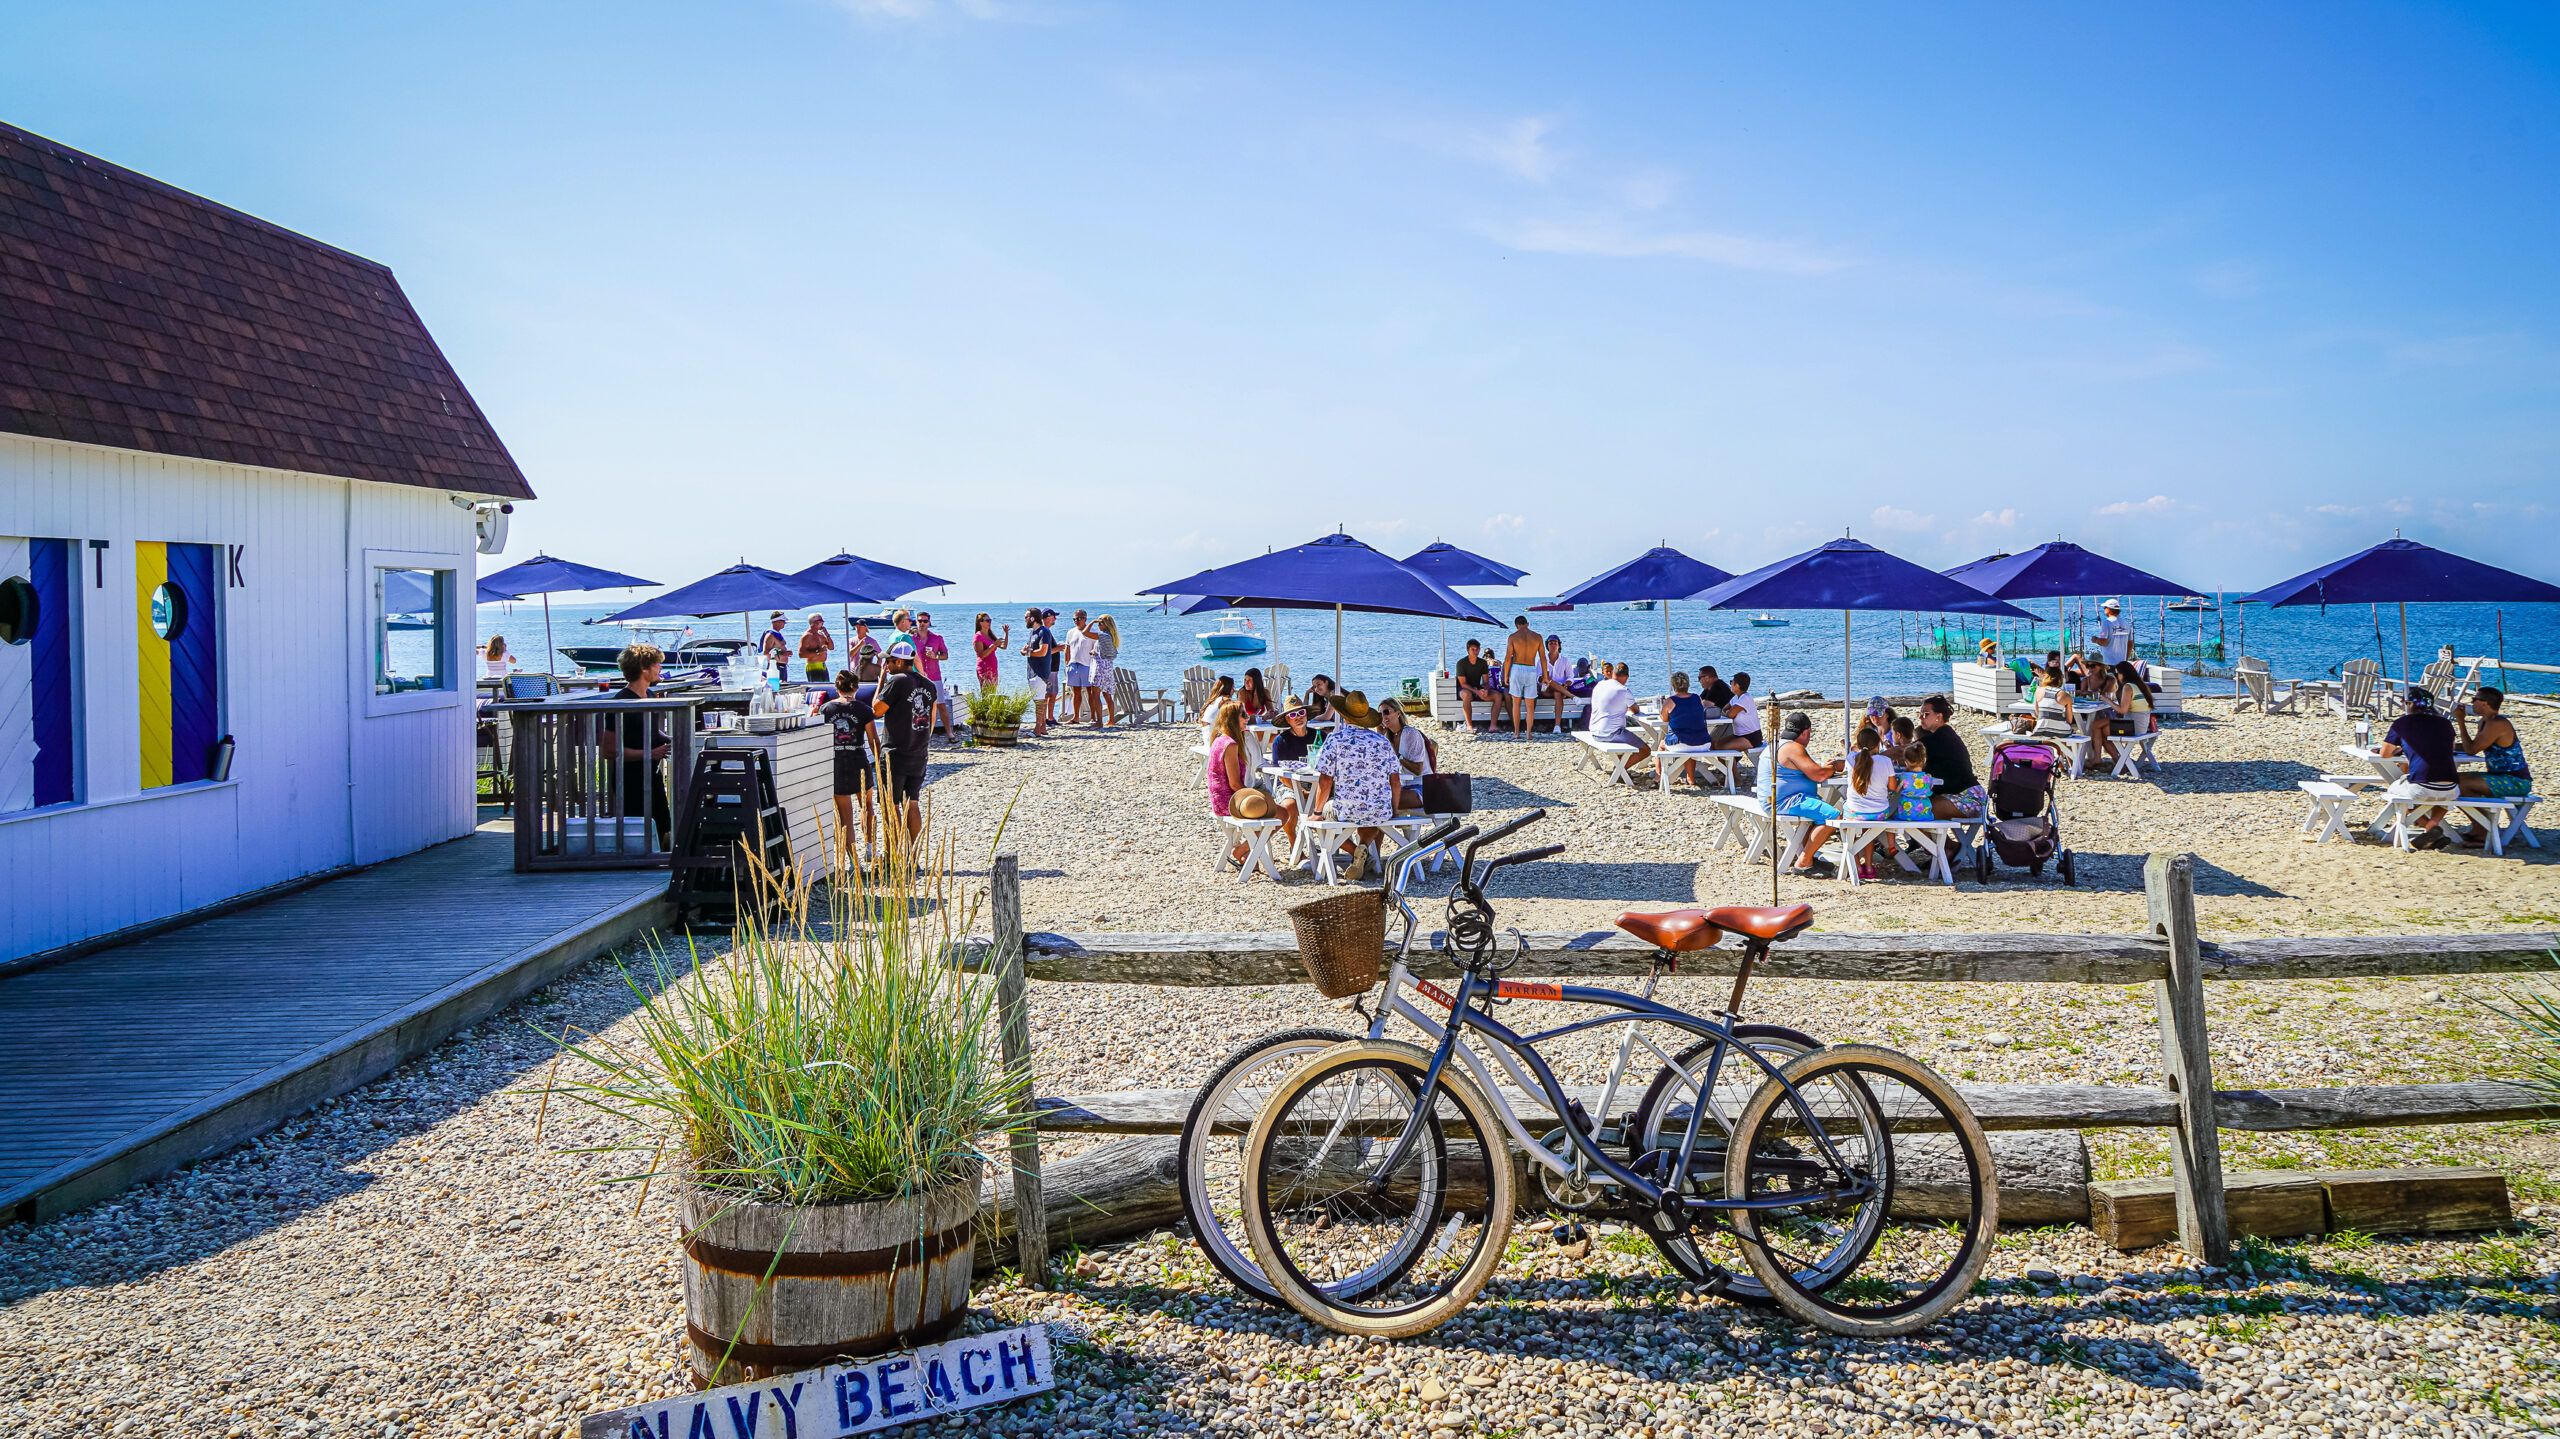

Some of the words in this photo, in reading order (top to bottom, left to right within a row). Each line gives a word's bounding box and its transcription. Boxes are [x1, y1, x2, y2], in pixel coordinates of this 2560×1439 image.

[89, 540, 109, 588] T
[228, 544, 245, 588] K
[1422, 984, 1453, 1007] MARR
[1503, 985, 1557, 997] MARRAM
[835, 1333, 1037, 1429] BEACH
